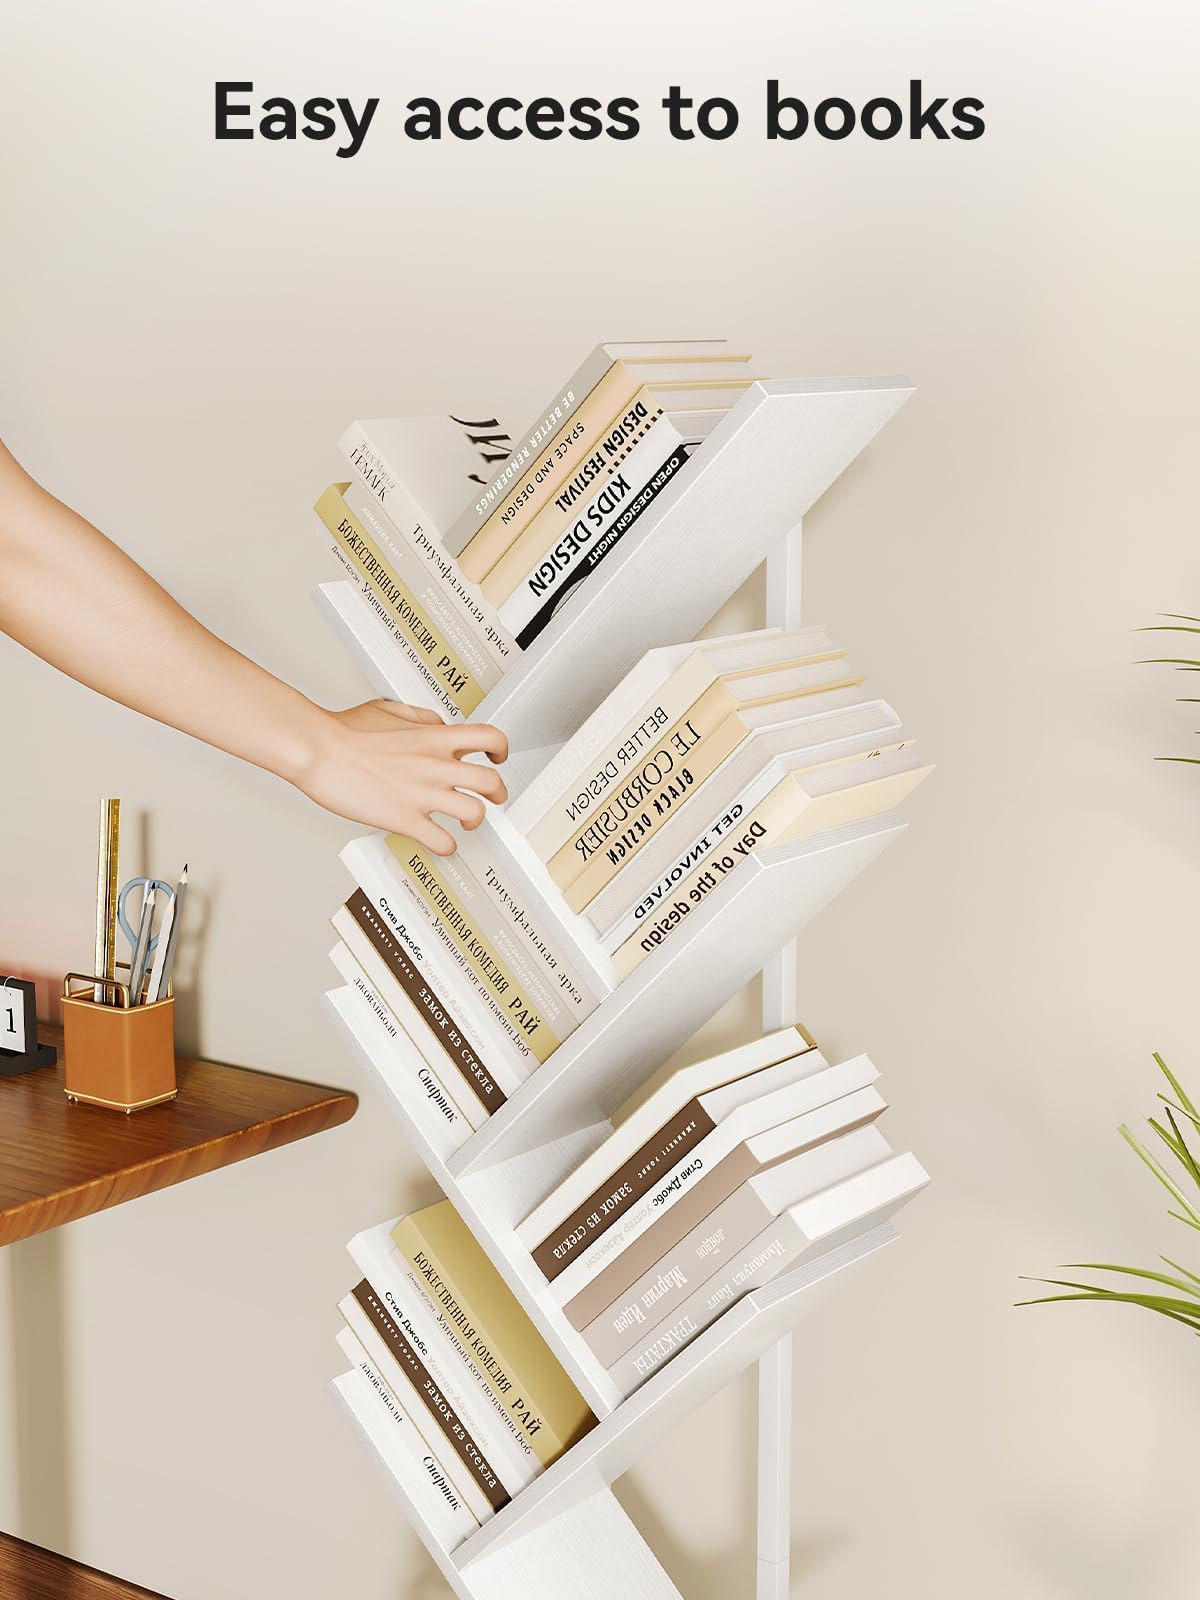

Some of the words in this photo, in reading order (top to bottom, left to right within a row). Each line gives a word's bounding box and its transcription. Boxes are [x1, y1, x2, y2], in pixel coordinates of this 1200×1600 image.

[562, 390, 575, 408] BE
[530, 407, 562, 448] BETTER
[555, 422, 584, 459] SPACE
[603, 402, 648, 456] DESIGN
[476, 446, 530, 515] RENDERINGS
[535, 458, 554, 483] AND
[555, 452, 606, 512] FESTIVAL
[652, 458, 679, 490] OPEN
[502, 483, 534, 524] DESIGN
[588, 473, 631, 527] KIDS
[617, 488, 653, 530] DESIGN
[528, 520, 592, 597] DESIGN
[588, 529, 618, 566] NIGHT
[338, 519, 400, 604] БОЖЕСТВЕННАЯ
[396, 598, 437, 654] КОМЕДИЯ
[437, 656, 468, 692] РАЙ
[414, 524, 484, 622] Триумфальная
[485, 627, 508, 656] арка
[362, 582, 396, 630] Уличный
[394, 630, 408, 648] кот
[407, 649, 418, 663] по
[417, 662, 442, 696] имени
[441, 693, 460, 716] Боб
[380, 898, 397, 924] Стив
[396, 925, 422, 960] Джобс
[409, 854, 472, 941] БОЖЕСТВЕННАЯ
[468, 938, 509, 994] КОМЕДИЯ
[509, 997, 540, 1035] РАЙ
[486, 866, 557, 968] Триумфальная
[558, 974, 582, 1004] арка
[432, 918, 467, 966] Уличный
[465, 967, 479, 984] кот
[478, 987, 489, 1000] по
[489, 1001, 513, 1035] имени
[512, 1033, 531, 1056] Боб
[6, 1008, 17, 1034] 1
[419, 988, 448, 1029] замок
[448, 1030, 461, 1047] из
[462, 1050, 493, 1094] стекла
[418, 1067, 458, 1123] Спартак
[653, 1176, 681, 1206] Джобс
[681, 1159, 702, 1180] Стив
[587, 1212, 601, 1228] из
[600, 1182, 632, 1215] замок
[622, 1204, 654, 1232] Уолтер
[553, 1226, 586, 1258] стекла
[637, 1263, 690, 1311] Мартин
[386, 1292, 402, 1318] Стив
[402, 1320, 427, 1355] Джобс
[414, 1252, 475, 1339] БОЖЕСТВЕННАЯ
[471, 1338, 512, 1393] КОМЕДИЯ
[512, 1398, 542, 1436] РАЙ
[610, 1302, 647, 1336] Иден
[633, 1316, 697, 1375] ТРАКТАТЫ
[437, 1314, 470, 1362] Уличный
[469, 1363, 483, 1380] кот
[482, 1383, 492, 1397] по
[492, 1398, 516, 1432] имени
[515, 1432, 532, 1454] Боб
[424, 1380, 453, 1421] замок
[452, 1424, 465, 1440] из
[466, 1444, 496, 1488] стекла
[422, 1455, 461, 1511] Спартак
